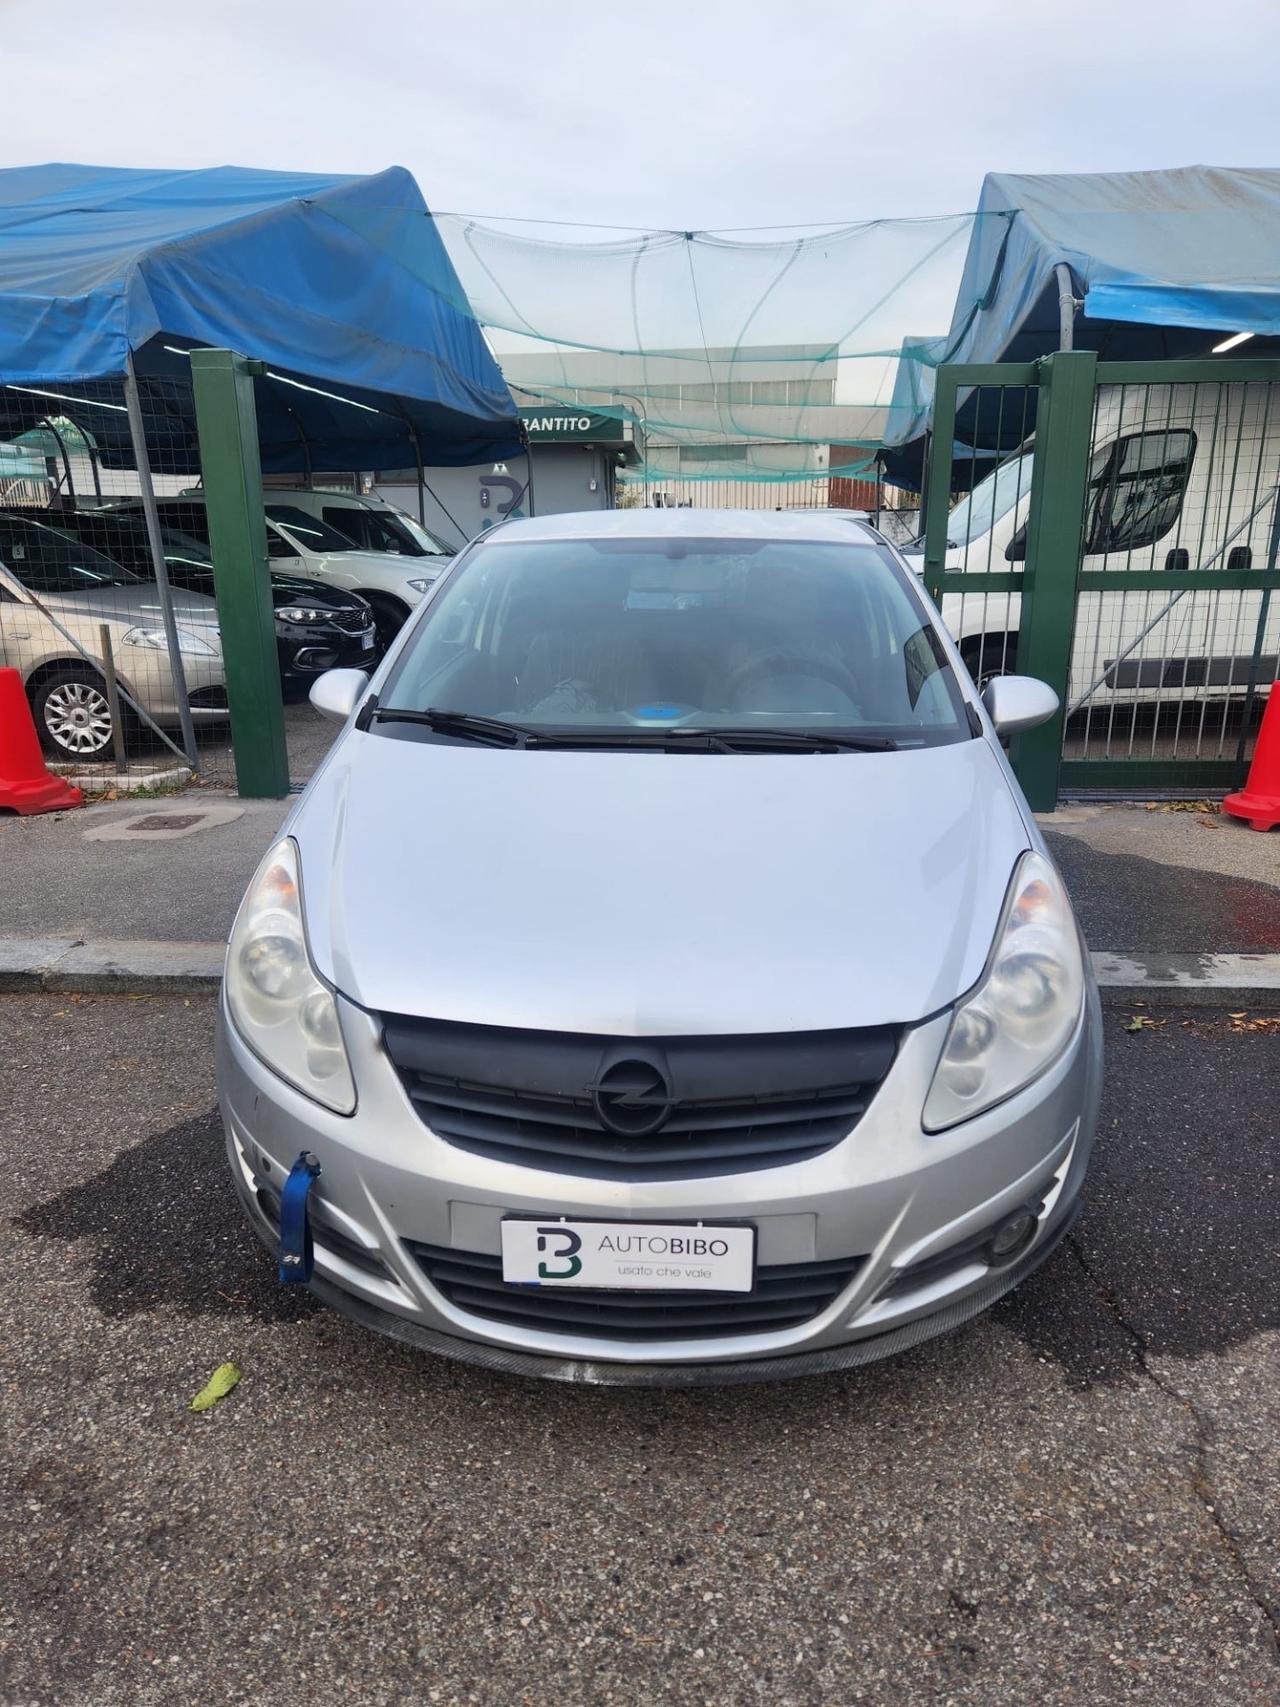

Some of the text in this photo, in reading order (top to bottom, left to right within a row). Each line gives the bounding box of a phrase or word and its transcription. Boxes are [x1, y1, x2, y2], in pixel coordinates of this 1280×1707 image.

[598, 1235, 729, 1257] AUTOBIBO
[618, 1266, 712, 1279] usato che vale
